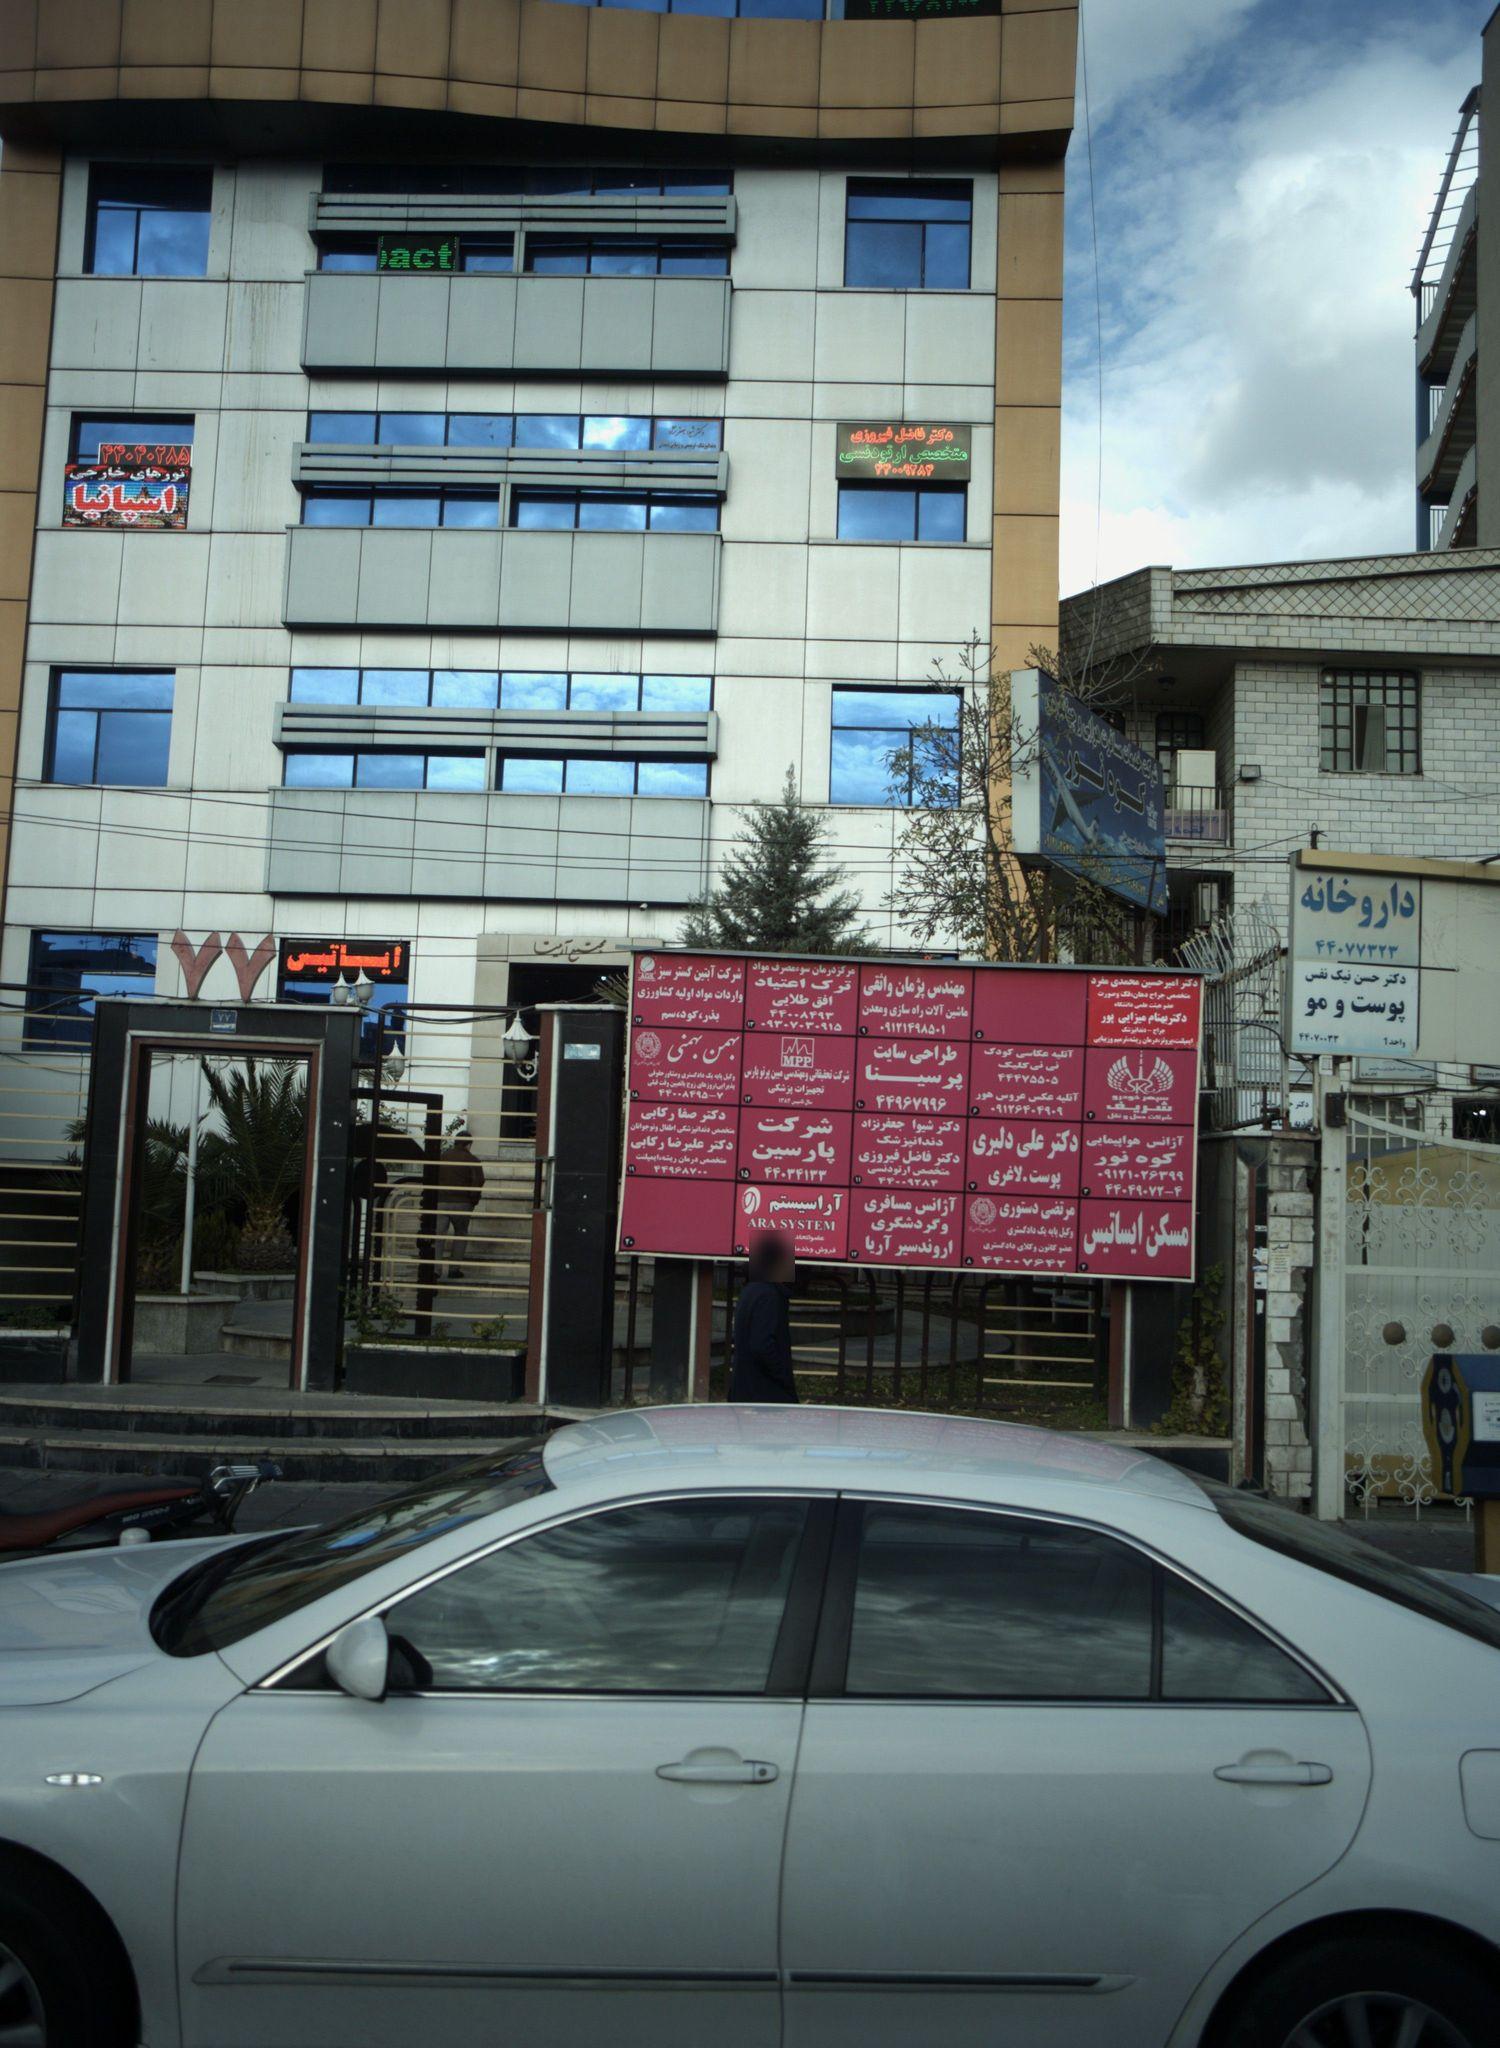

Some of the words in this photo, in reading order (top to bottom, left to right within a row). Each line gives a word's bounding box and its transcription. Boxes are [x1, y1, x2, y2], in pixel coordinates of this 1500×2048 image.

[851, 426, 894, 443] فیروزی
[895, 427, 926, 443] فاضل
[926, 428, 953, 445] دکتر
[101, 445, 190, 465] ۴۴۰۴۰۲۸۵
[840, 443, 907, 464] ارتودنسی
[909, 446, 968, 464] متخصص
[70, 467, 125, 480] خارجی
[130, 467, 186, 482] تورهای
[73, 482, 177, 522] اسپانیا
[1064, 750, 1104, 790] نور
[1108, 769, 1146, 815] کوه
[1301, 876, 1415, 928] داروخانه
[171, 928, 277, 1002] ۷۷
[752, 963, 769, 973] مواد
[657, 966, 672, 979] سبز
[673, 966, 692, 981] گستر
[694, 965, 716, 982] آبتین
[717, 967, 741, 983] شرکت
[1305, 968, 1327, 982] نفس
[1331, 970, 1351, 983] نیک
[755, 977, 806, 990] اعتیاد
[1111, 978, 1140, 987] محمدی
[1141, 978, 1179, 989] امیرحسین
[1180, 979, 1198, 990] دکتر
[1354, 974, 1379, 985] حسن
[1382, 973, 1406, 987] دکتر
[637, 986, 673, 999] کشاورزی
[810, 980, 851, 993] ترک
[895, 976, 925, 999] پژمان
[927, 980, 965, 998] مهندس
[675, 987, 694, 1000] اولیه
[695, 988, 713, 1001] مواد
[714, 988, 744, 1003] واردات
[772, 993, 809, 1006] طلایی
[812, 995, 833, 1008] افق
[1304, 997, 1327, 1016] مو
[770, 1010, 834, 1020] ۴۴۰۰۸۴۹۳
[862, 1005, 887, 1017] ومعدن
[889, 1004, 910, 1017] سازی
[912, 1005, 923, 1017] راه
[925, 1004, 944, 1016] آلات
[945, 1007, 969, 1019] ماشین
[1333, 999, 1344, 1019] و
[1351, 996, 1405, 1023] پوست
[1101, 1014, 1114, 1024] پور
[1148, 1012, 1168, 1024] بهنام
[1168, 1012, 1187, 1025] دکتر
[880, 1022, 946, 1035] ۰۹۱۲۱۴۹۸۵۰۱
[667, 1033, 703, 1062] بهمنی
[702, 1036, 740, 1064] بهمن
[874, 1043, 907, 1062] سایت
[984, 1048, 1014, 1058] کودک
[910, 1045, 957, 1066] طراحی
[1016, 1050, 1049, 1059] عکاسی
[1051, 1050, 1073, 1060] آتلیه
[783, 1056, 811, 1067] MPP
[998, 1061, 1029, 1069] کلیک
[1030, 1061, 1043, 1071] نی
[1045, 1062, 1059, 1071] نی
[681, 1071, 704, 1079] دادگستری
[833, 1070, 850, 1083] شرکت
[865, 1064, 963, 1091] پرسینا
[768, 1084, 793, 1094] پزشکی
[794, 1085, 825, 1095] تجهیزات
[976, 1091, 994, 1100] هور
[876, 1095, 947, 1111] ۴۴۹۶۷۹۹۶
[995, 1093, 1026, 1102] عروس
[1028, 1093, 1054, 1103] عکس
[1056, 1093, 1079, 1103] آتلیه
[641, 1106, 675, 1121] رکابی
[678, 1108, 697, 1119] صفا
[1106, 1101, 1172, 1114] شریف
[700, 1110, 726, 1123] دکتر
[660, 1124, 676, 1132] اطفال
[677, 1126, 710, 1134] دندانپزشکی
[758, 1116, 833, 1139] شرکت
[861, 1117, 905, 1131] جعفرنژاد
[912, 1119, 934, 1133] شیوا
[936, 1121, 960, 1134] دکتر
[630, 1136, 664, 1150] رکابی
[668, 1137, 704, 1151] علیرضا
[707, 1140, 733, 1153] دکتر
[876, 1135, 943, 1147] دندانپزشک
[972, 1126, 1014, 1156] دلیری
[1017, 1128, 1044, 1157] علی
[1047, 1130, 1079, 1159] دکتر
[1086, 1135, 1141, 1148] هواپیمایی
[1146, 1136, 1184, 1149] آژانس
[752, 1141, 835, 1164] پارسین
[859, 1149, 900, 1163] فیروزی
[902, 1151, 932, 1164] فاضل
[1094, 1151, 1129, 1166] نور
[678, 1156, 698, 1164] درمان
[935, 1153, 960, 1166] دکتر
[1136, 1152, 1176, 1167] کوه
[764, 1167, 827, 1182] ۴۴۰۳۴۱۳۳
[867, 1166, 910, 1175] ارتودنسی
[913, 1167, 950, 1176] متخصص
[1098, 1169, 1183, 1181] ۰۹۱۲۱۰۲۶۳۹۹
[769, 1194, 843, 1216] آراسیستم
[864, 1194, 912, 1213] مسافری
[915, 1197, 957, 1216] آژانس
[999, 1201, 1038, 1218] دستوری
[1041, 1201, 1075, 1220] مرتضی
[748, 1218, 776, 1229] ARA
[780, 1219, 835, 1231] SYSTEM
[1007, 1225, 1036, 1235] دادگستری
[1059, 1228, 1074, 1238] وکیل
[1084, 1211, 1143, 1255] ایساتیس
[1145, 1213, 1189, 1257] مسکن
[815, 1246, 836, 1254] فروش
[865, 1235, 892, 1255] آریا
[895, 1239, 953, 1258] اروندسیر
[983, 1242, 1016, 1250] دادگستری
[1017, 1243, 1037, 1252] وکلای
[1038, 1245, 1057, 1253] کانون
